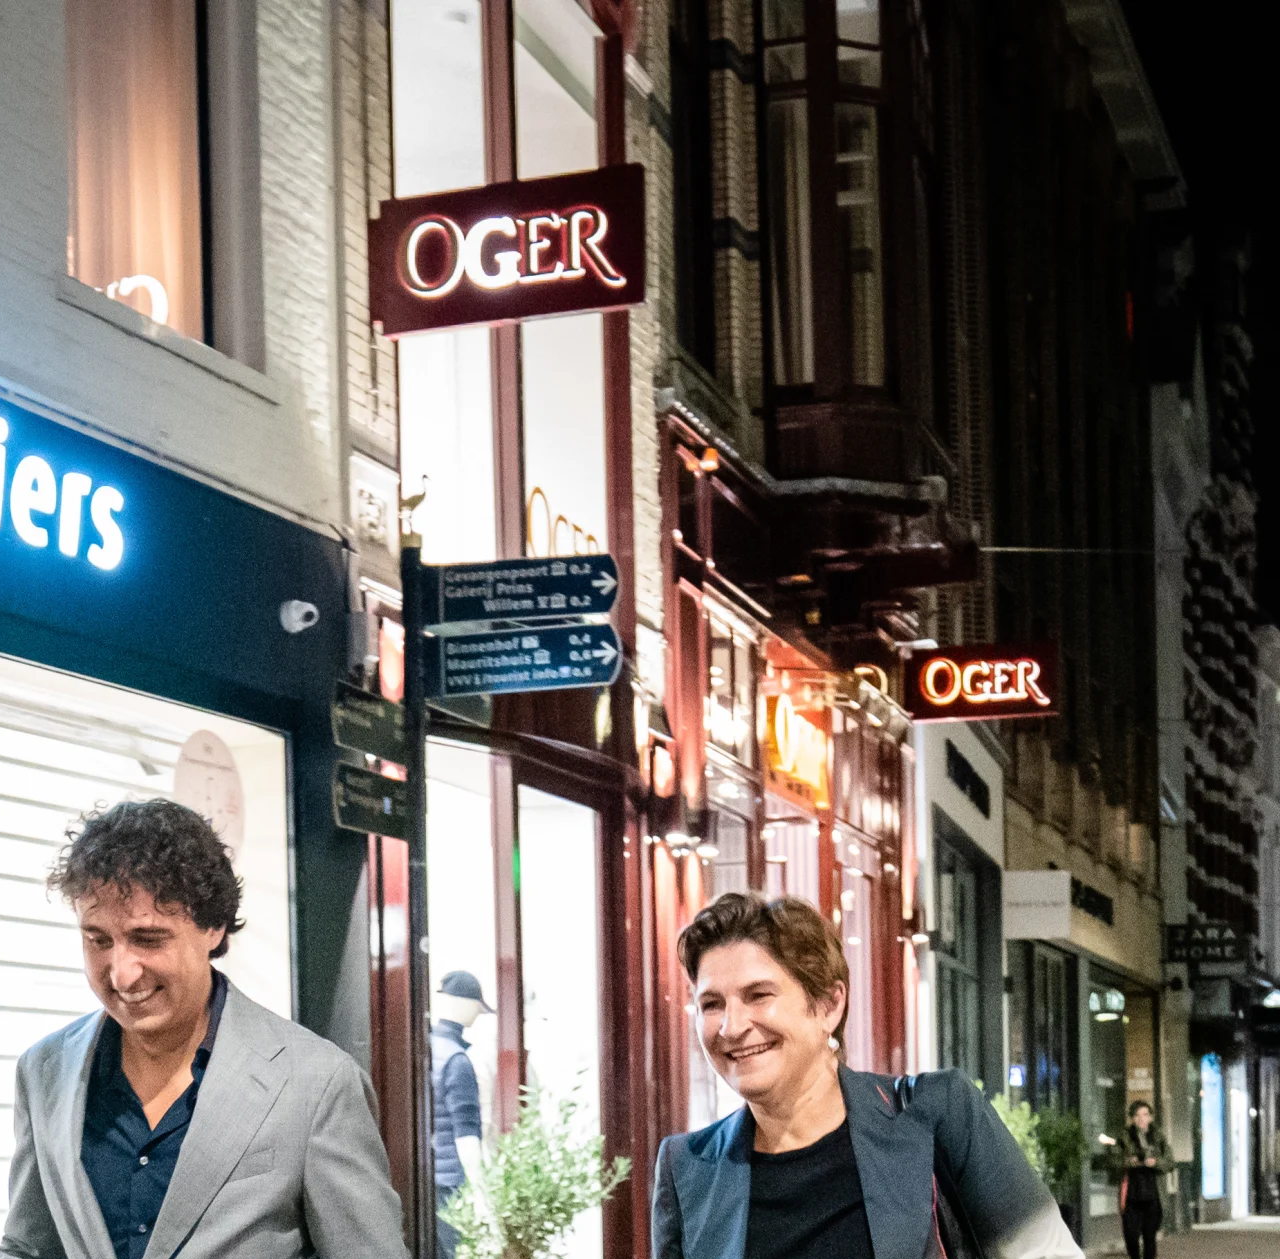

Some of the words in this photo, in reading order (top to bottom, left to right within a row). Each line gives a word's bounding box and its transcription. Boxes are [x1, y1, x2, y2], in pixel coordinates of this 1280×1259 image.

[396, 204, 628, 301] OGER
[444, 563, 548, 583] Gevangenpoort
[444, 581, 494, 600] Galerij
[495, 582, 534, 595] Prins
[482, 597, 535, 612] Willem
[446, 636, 520, 655] Binnenhof
[446, 652, 532, 670] Mauritshuis
[919, 657, 1051, 707] OGER
[1174, 927, 1238, 941] ZARA
[1173, 945, 1236, 958] HOME
